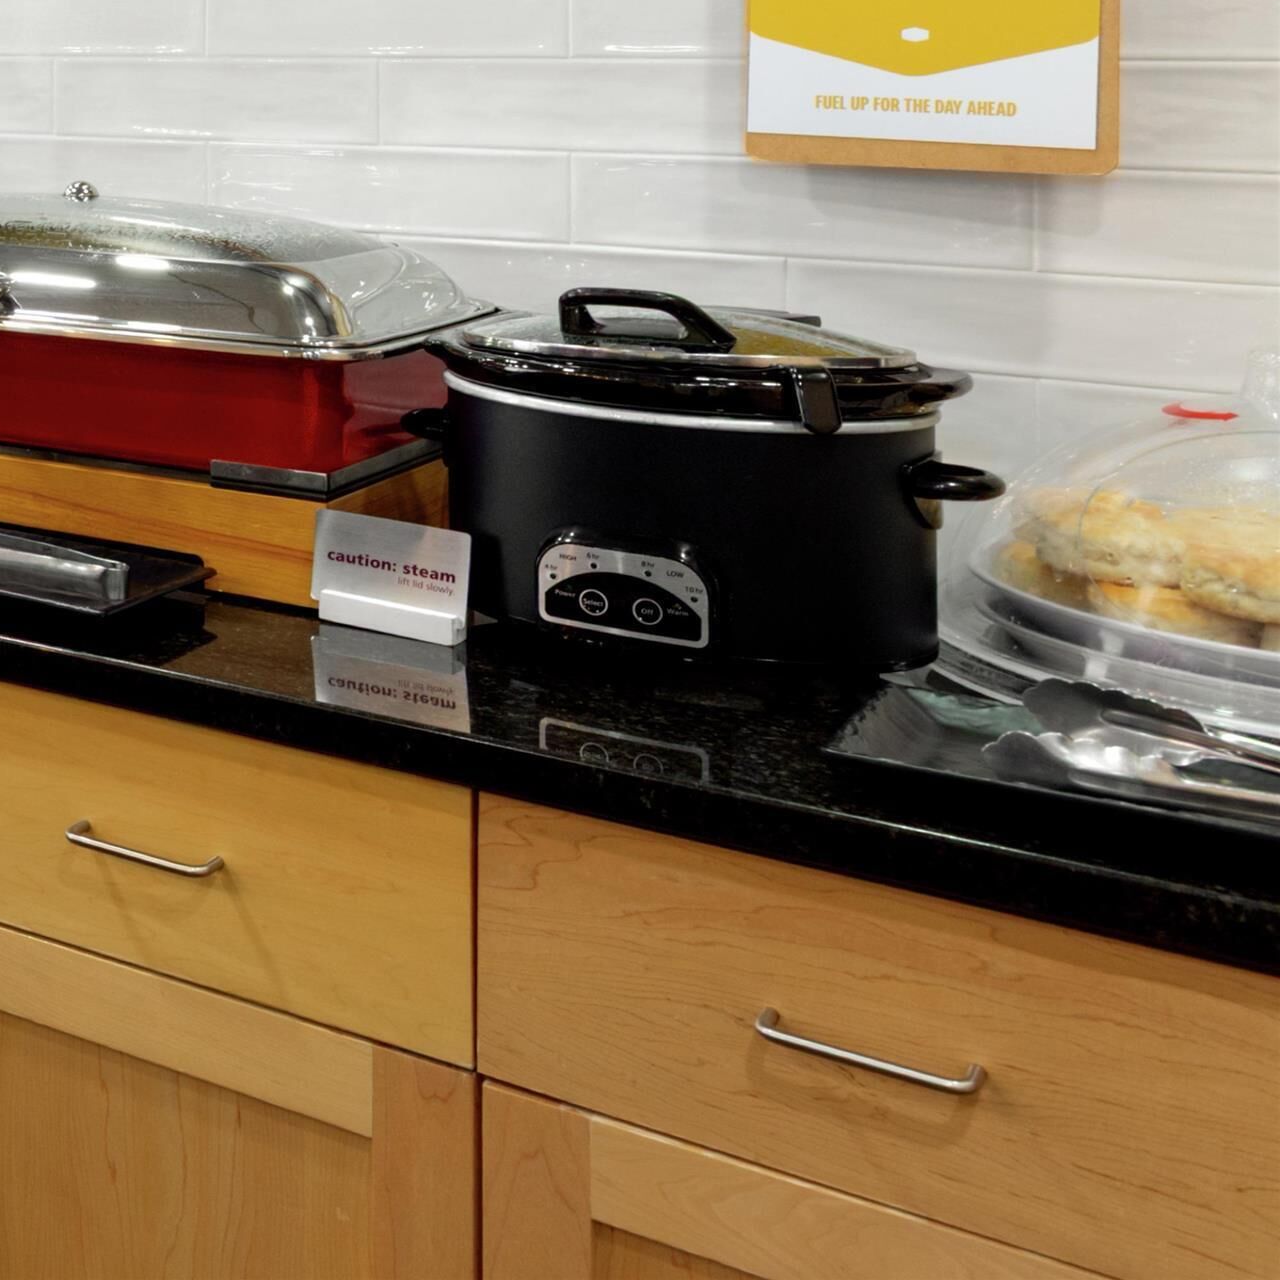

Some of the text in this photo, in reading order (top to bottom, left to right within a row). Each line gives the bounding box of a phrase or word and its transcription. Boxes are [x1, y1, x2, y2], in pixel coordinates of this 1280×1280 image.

[815, 95, 1016, 117] FUEL UP FOR THE DAY AHEAD
[327, 549, 456, 584] caution: steam
[666, 570, 684, 578] LOW
[641, 607, 653, 616] Off
